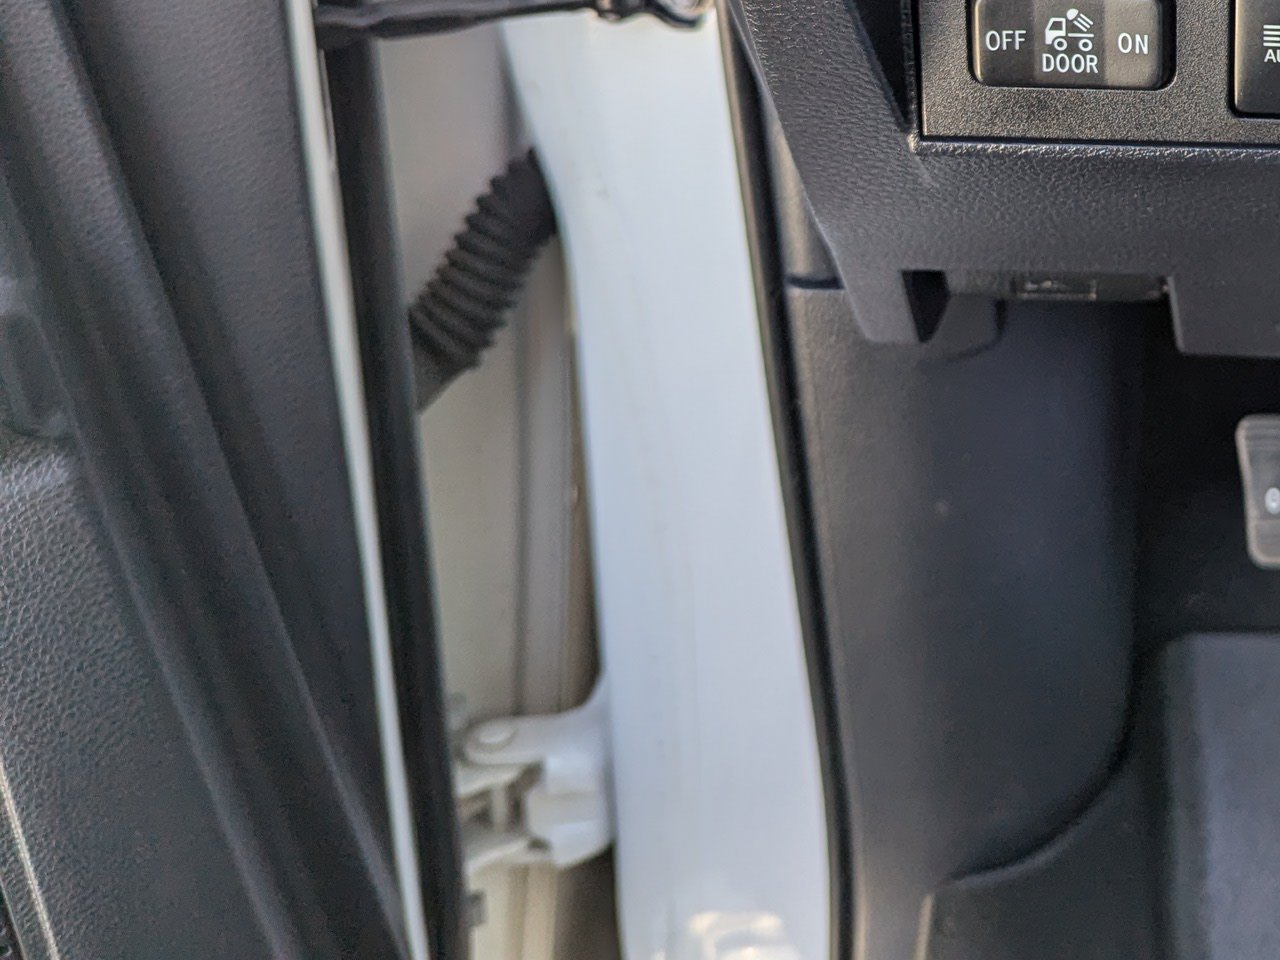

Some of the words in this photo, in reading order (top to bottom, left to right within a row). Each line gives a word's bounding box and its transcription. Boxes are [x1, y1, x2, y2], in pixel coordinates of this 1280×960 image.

[984, 30, 1027, 52] OFF
[1117, 31, 1150, 55] ON
[1041, 53, 1099, 74] DOOR
